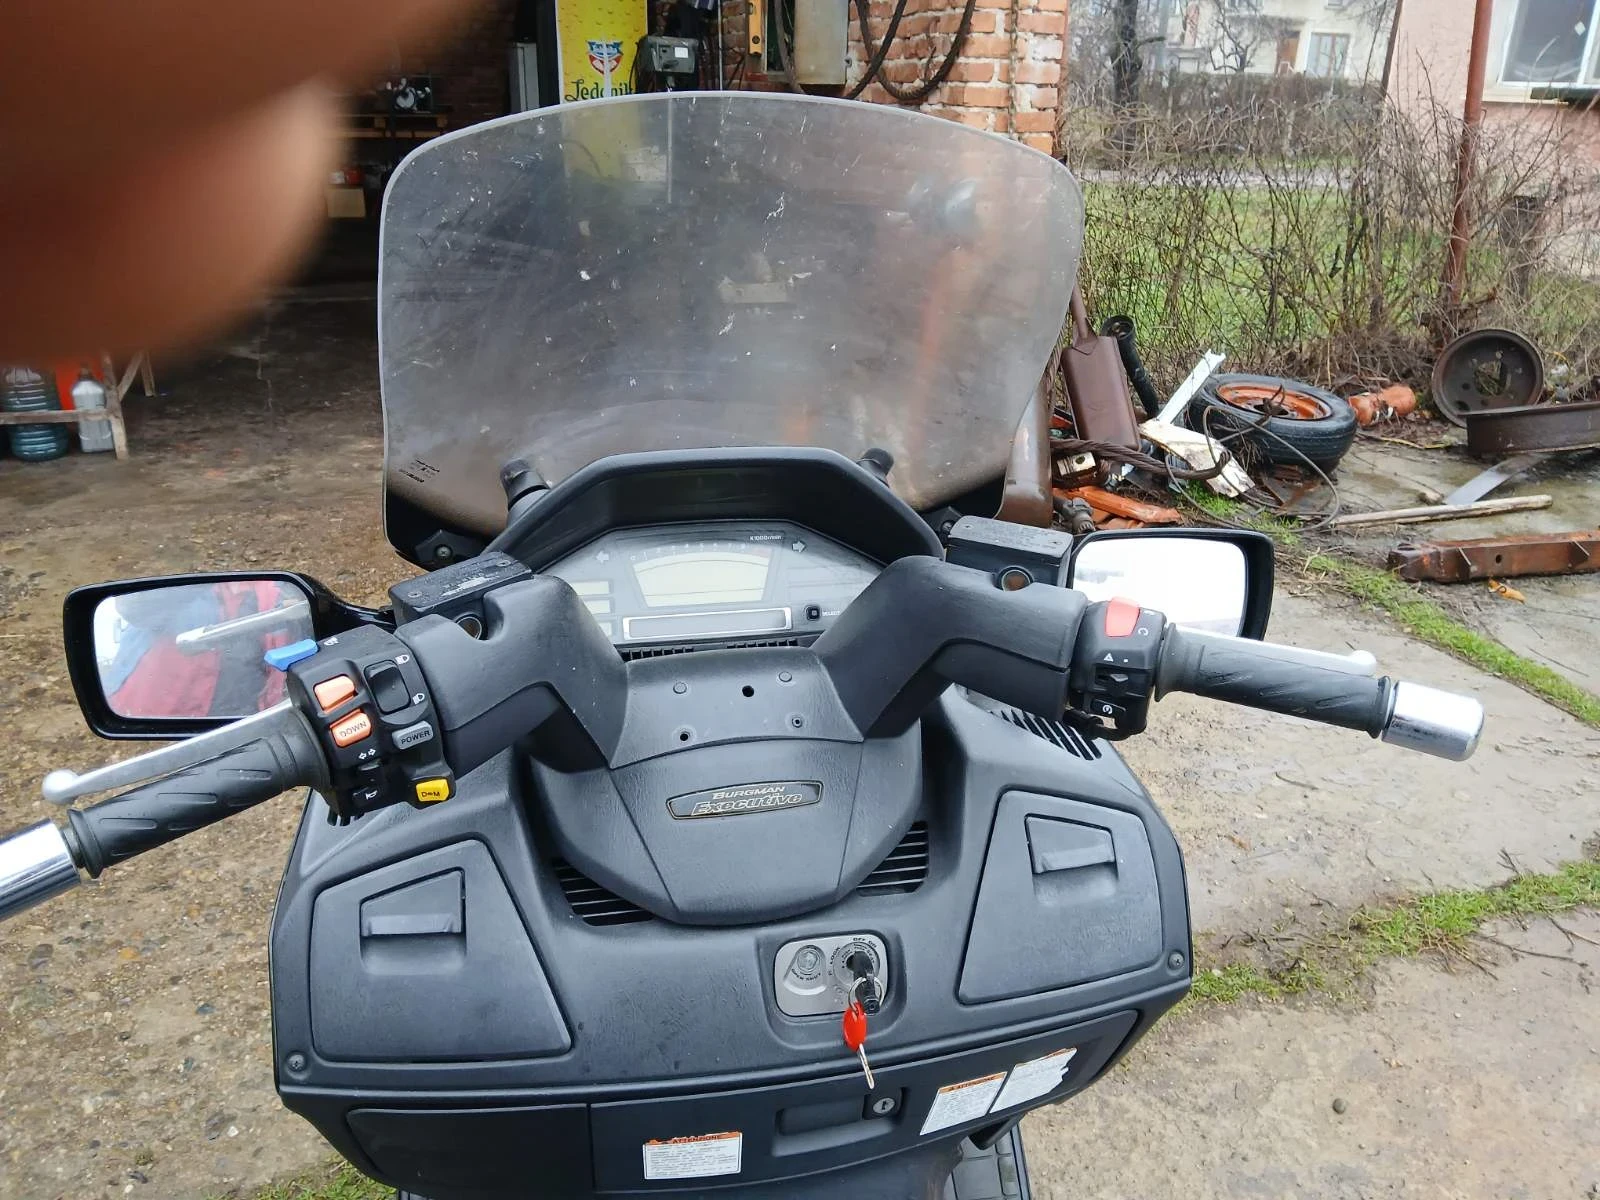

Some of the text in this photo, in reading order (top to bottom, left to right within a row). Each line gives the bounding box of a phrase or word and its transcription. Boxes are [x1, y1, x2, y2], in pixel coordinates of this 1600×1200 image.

[340, 721, 367, 738] DOWN
[400, 730, 431, 745] POWER
[691, 793, 803, 815] Executive
